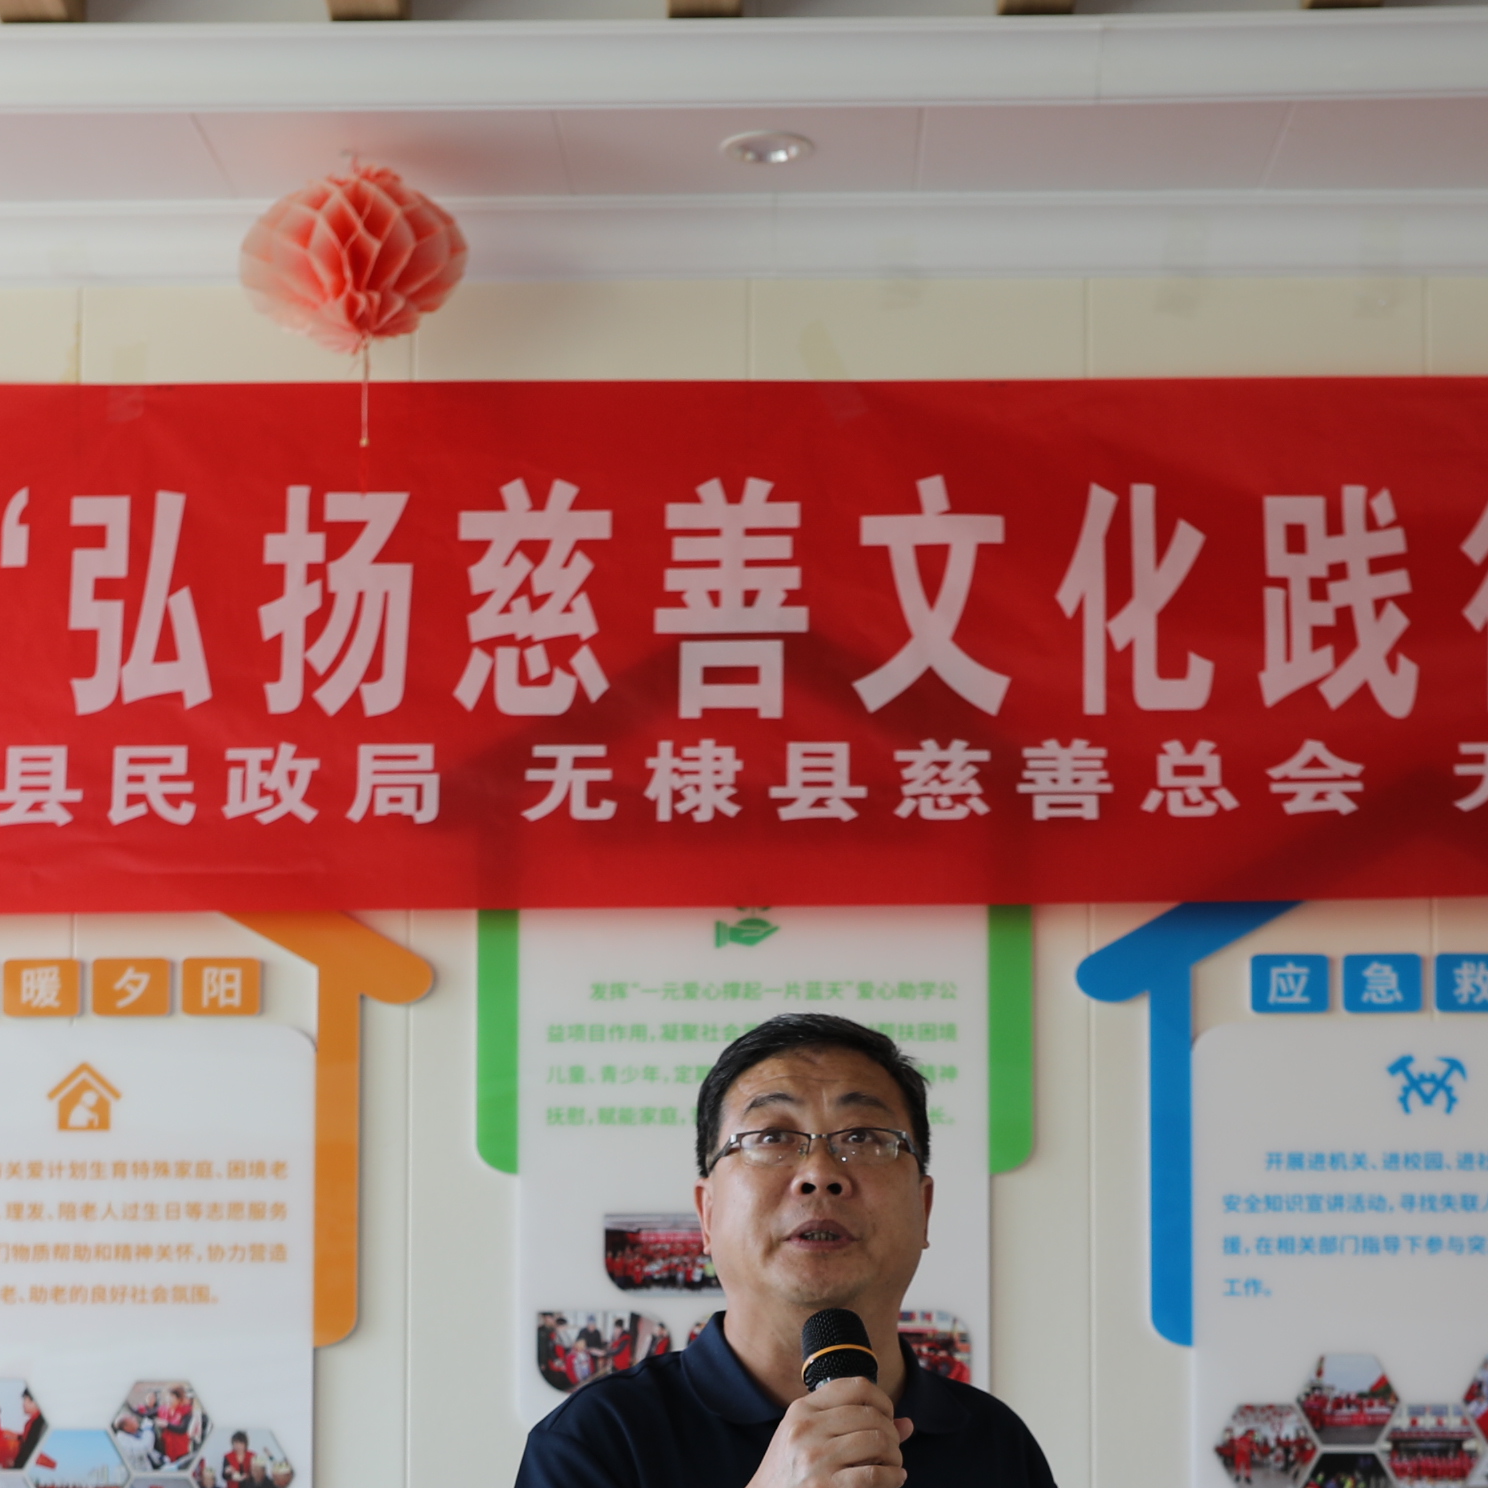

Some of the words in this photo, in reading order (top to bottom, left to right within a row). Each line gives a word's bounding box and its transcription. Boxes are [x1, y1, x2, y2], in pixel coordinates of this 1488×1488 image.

[520, 738, 1366, 822] 无棣县慈善总会
[548, 1022, 758, 1044] 益项目作用,凝聚社会
